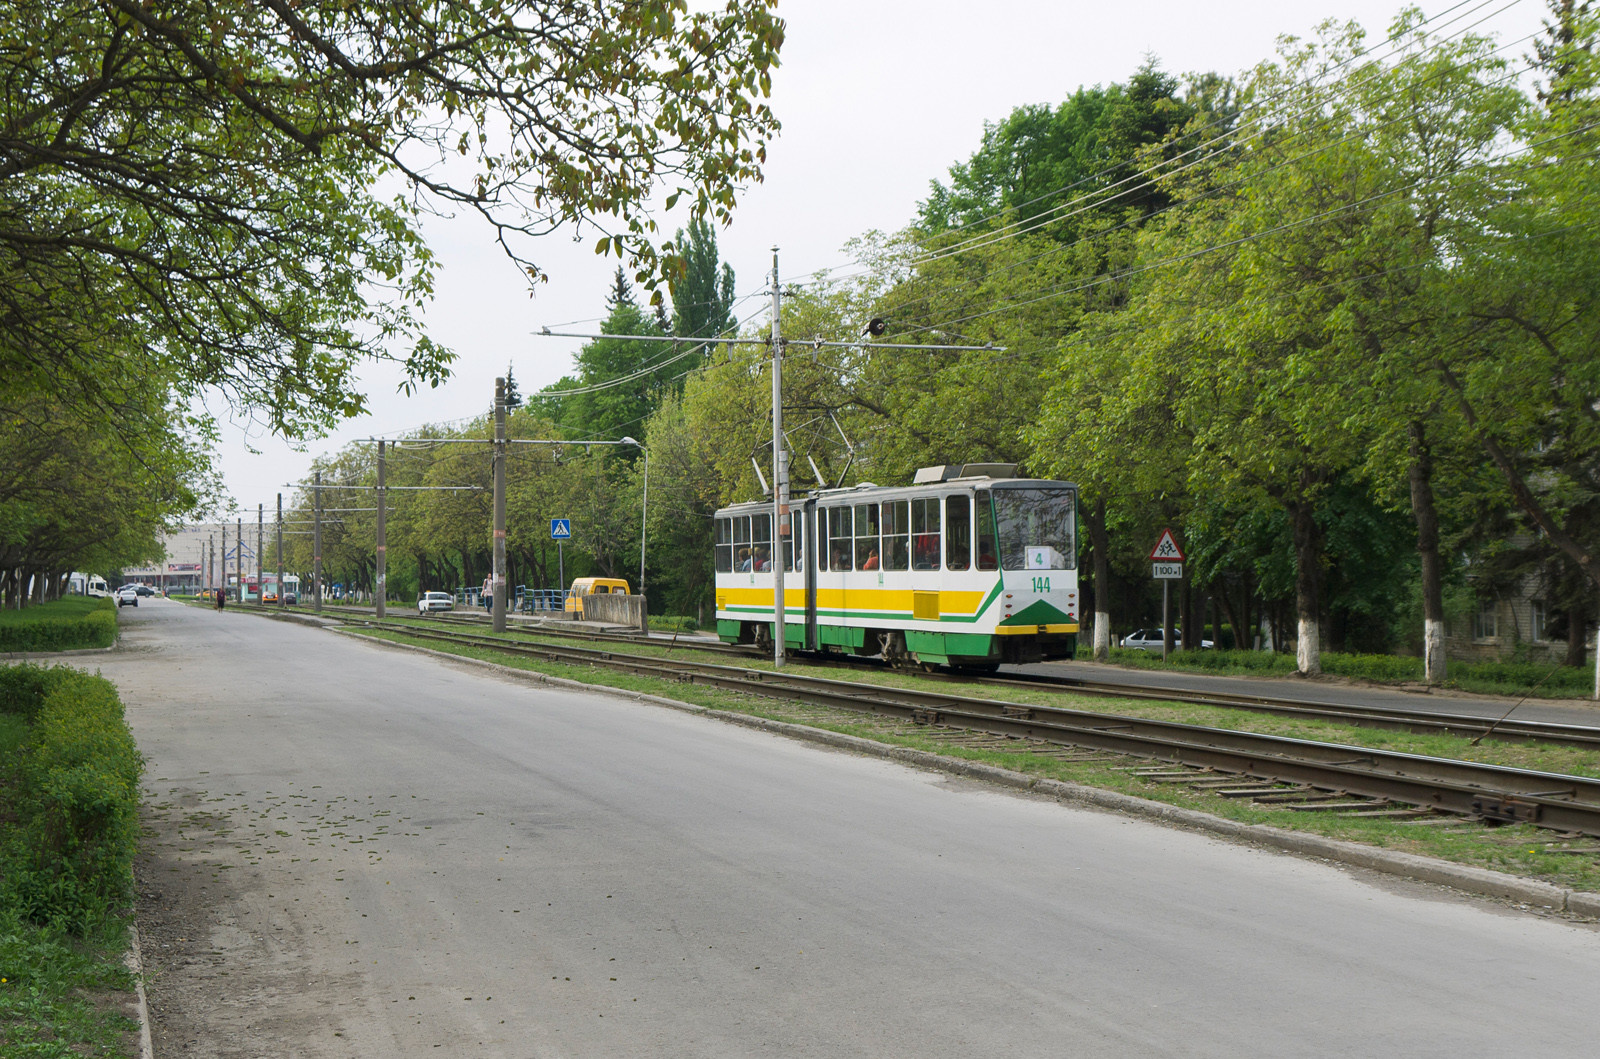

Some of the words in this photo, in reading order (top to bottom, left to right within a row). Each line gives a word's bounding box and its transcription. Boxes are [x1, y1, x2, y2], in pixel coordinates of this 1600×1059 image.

[1035, 552, 1043, 565] 4
[1159, 566, 1173, 575] 100
[1032, 576, 1050, 593] 144
